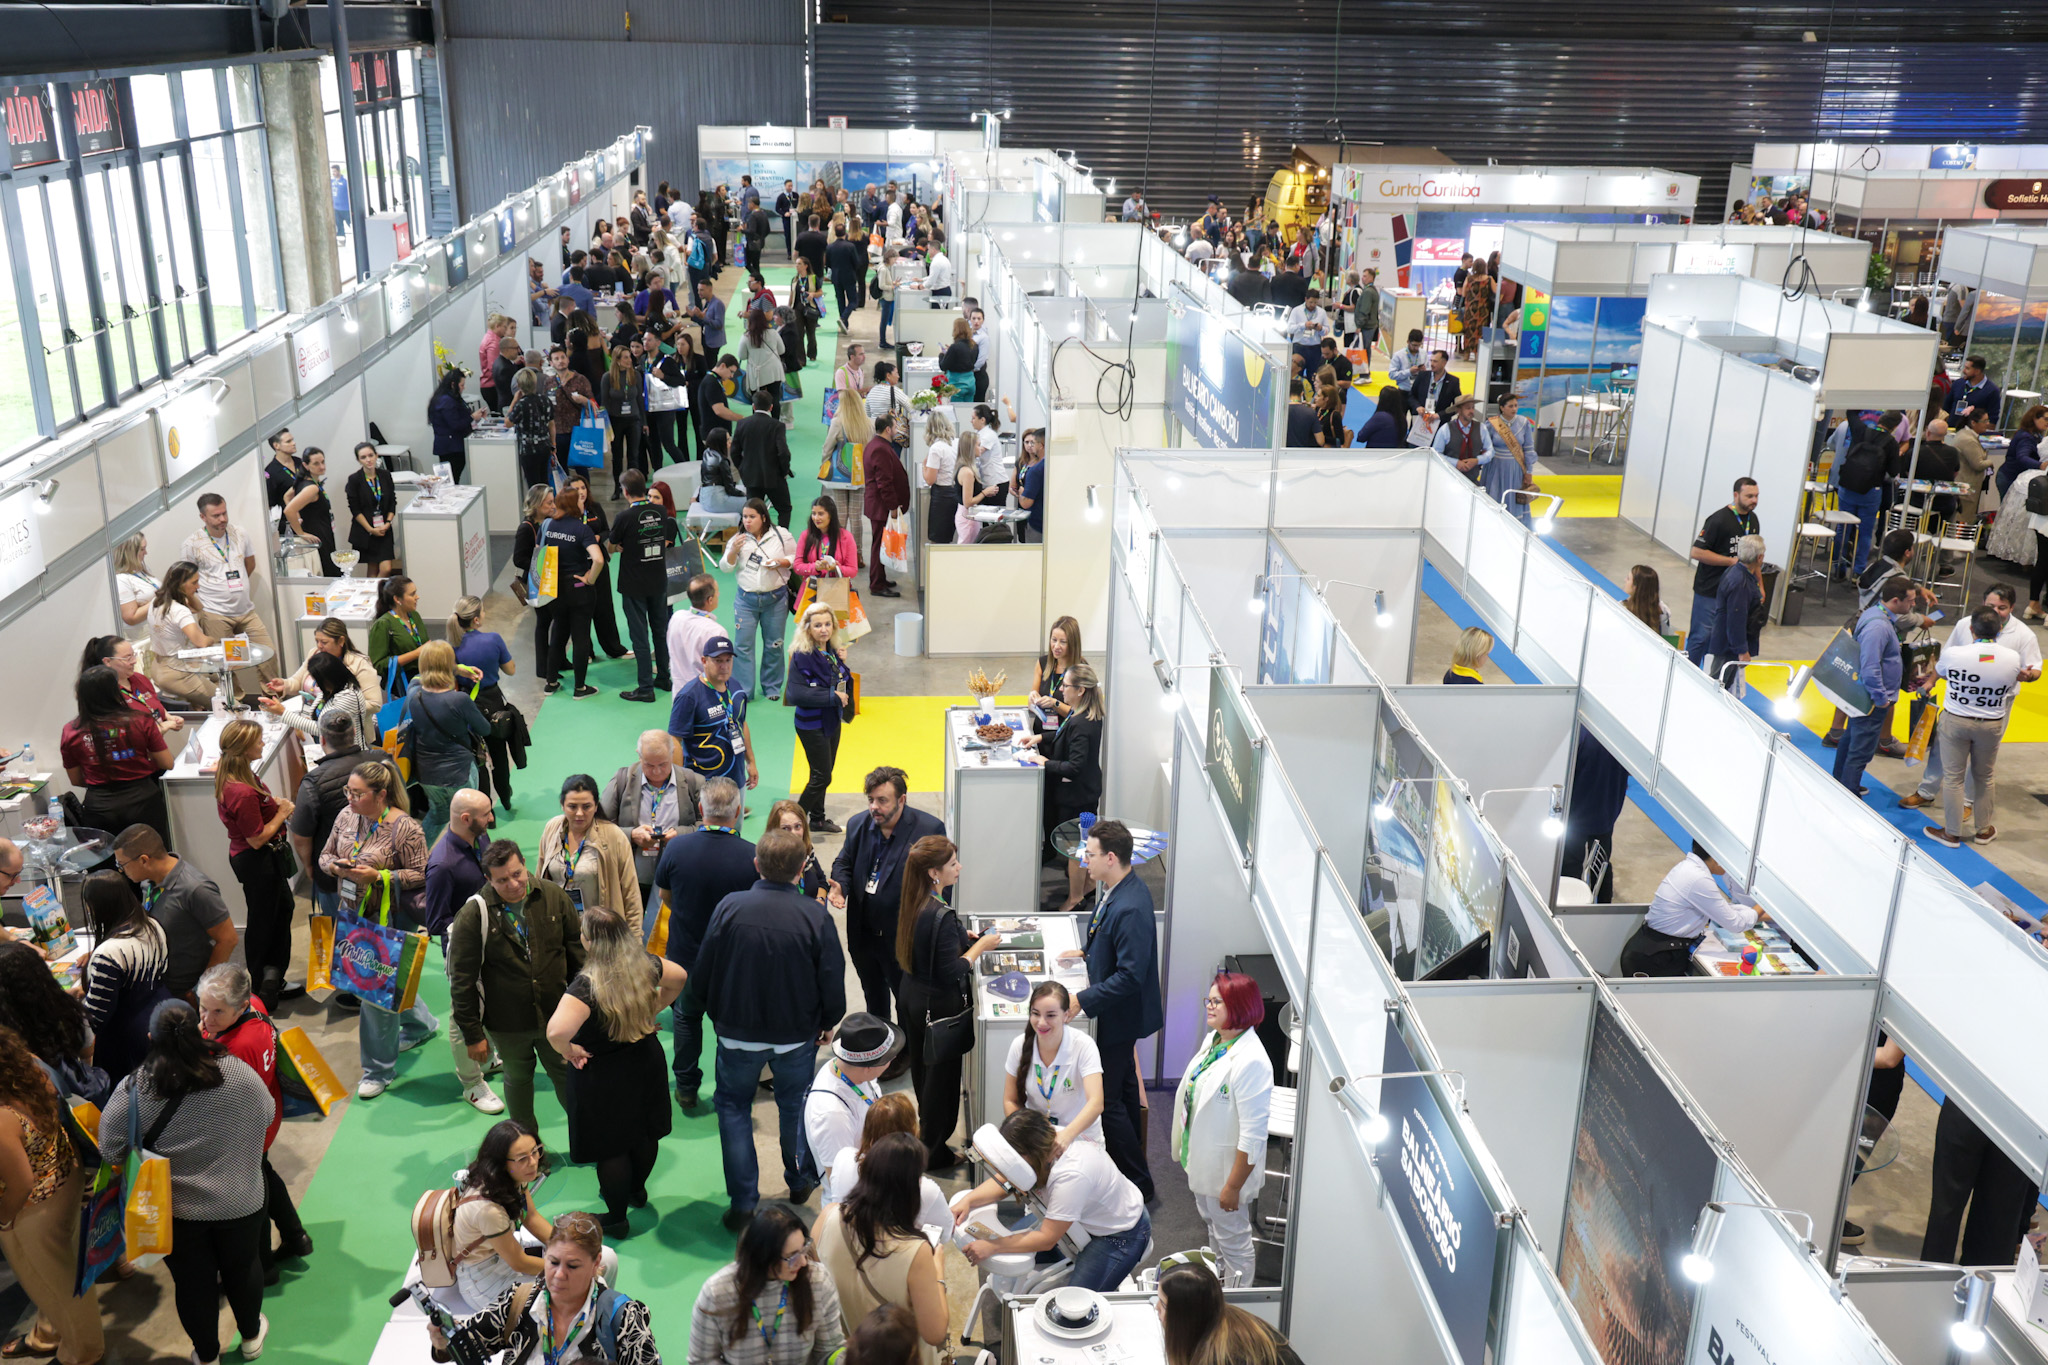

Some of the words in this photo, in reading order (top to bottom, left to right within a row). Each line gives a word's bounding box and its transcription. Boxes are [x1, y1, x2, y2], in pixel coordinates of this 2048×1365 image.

[2, 85, 48, 145] AÍDA
[2007, 194, 2039, 203] Sofistic
[546, 531, 577, 543] EUROPLUS
[1949, 669, 1981, 683] Rio
[1950, 692, 1970, 705] do
[1975, 696, 2004, 707] Sul
[337, 939, 395, 978] MultiParque
[863, 1045, 887, 1058] TRAVEL
[1402, 1116, 1461, 1250] BALNEÁRIO
[1400, 1146, 1456, 1273] SABOROSO
[1735, 1318, 1771, 1364] FESTIVAL
